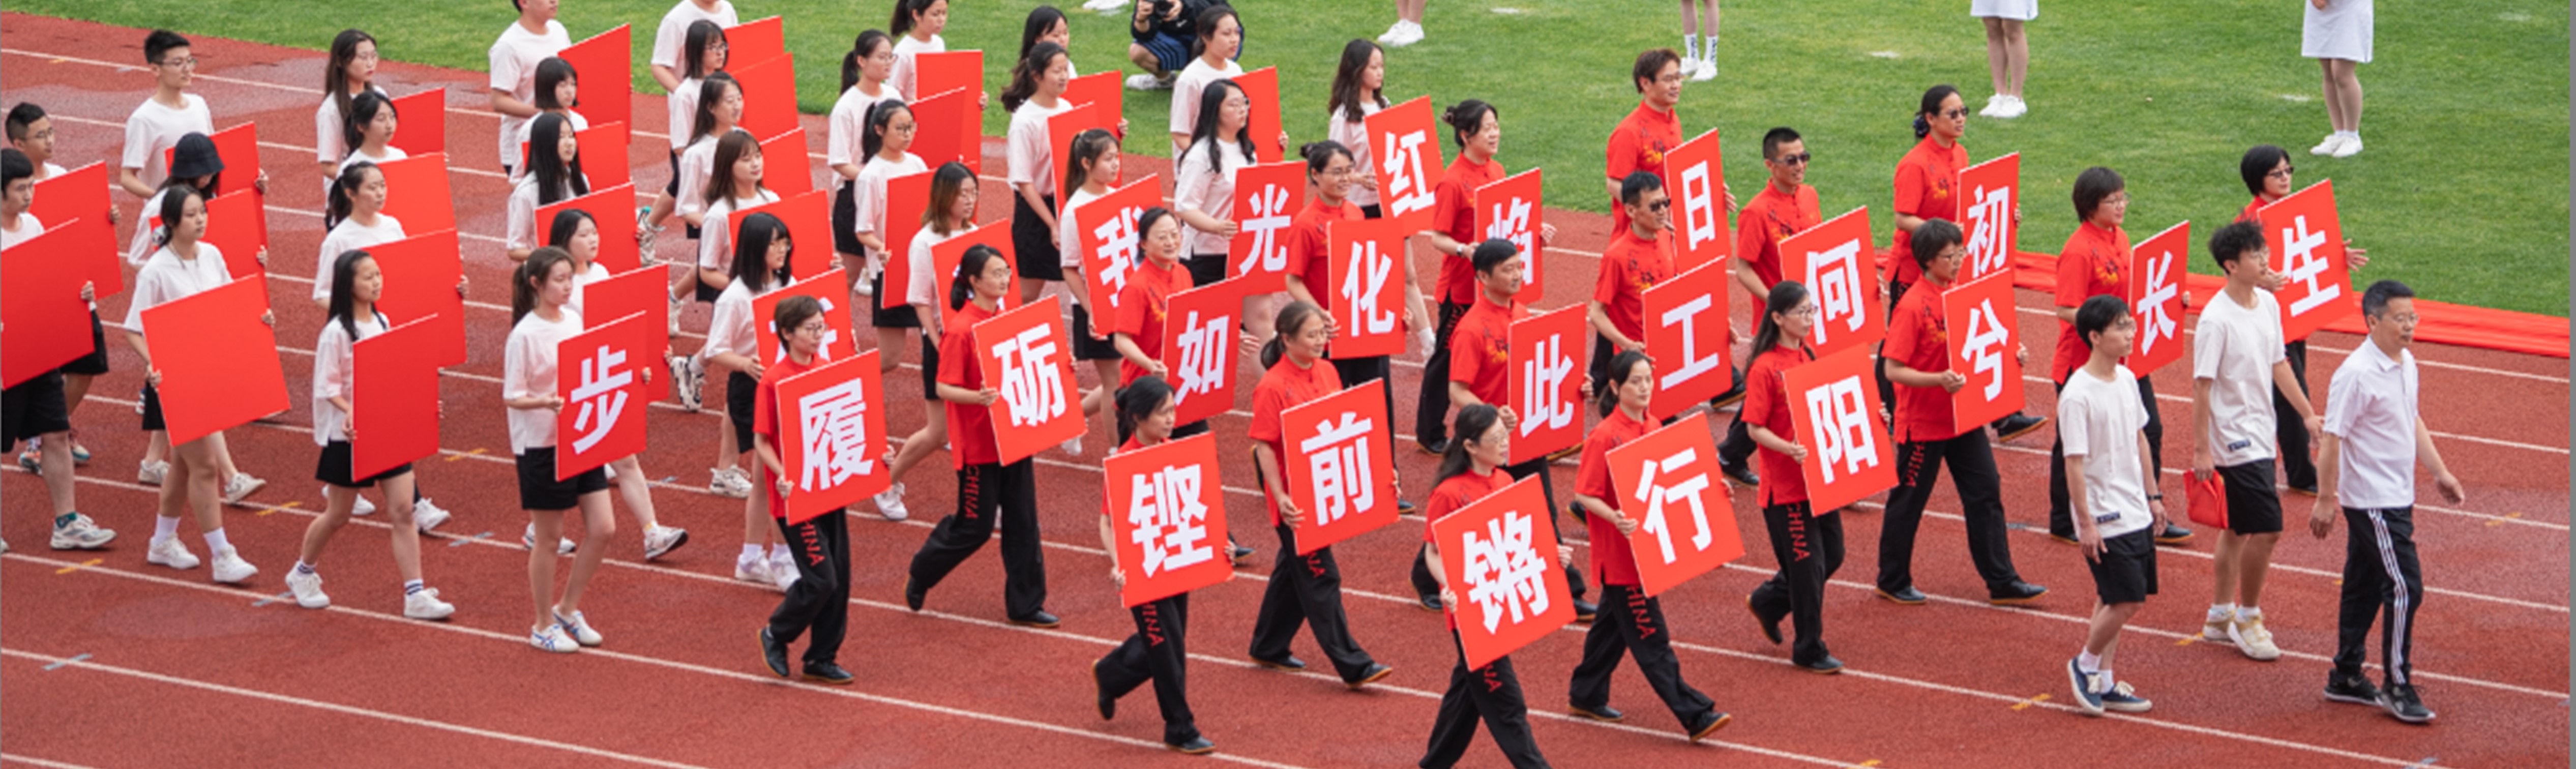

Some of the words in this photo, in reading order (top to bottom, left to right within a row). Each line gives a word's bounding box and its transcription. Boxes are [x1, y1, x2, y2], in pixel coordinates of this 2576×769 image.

[1383, 130, 1435, 217] 红
[1681, 161, 1715, 250] 日
[1239, 184, 1290, 276] 光
[1967, 184, 2009, 279] 初
[2283, 216, 2340, 317] 生
[1342, 241, 1395, 336] 化
[1805, 239, 1864, 345] 何
[2137, 251, 2176, 355] 长
[992, 323, 1065, 426] 砺
[1174, 311, 1229, 405] 如
[1521, 334, 1573, 436] 此
[1662, 294, 1718, 390] 工
[1963, 299, 2008, 400] 兮
[572, 346, 632, 453] 步
[800, 378, 873, 491] 履
[1805, 375, 1878, 484] 阳
[1301, 412, 1373, 525] 前
[1635, 448, 1711, 564] 行
[801, 519, 824, 566] HINA
[1129, 464, 1212, 577] 铿
[1463, 511, 1548, 634] 锵
[1625, 586, 1656, 639] HINA
